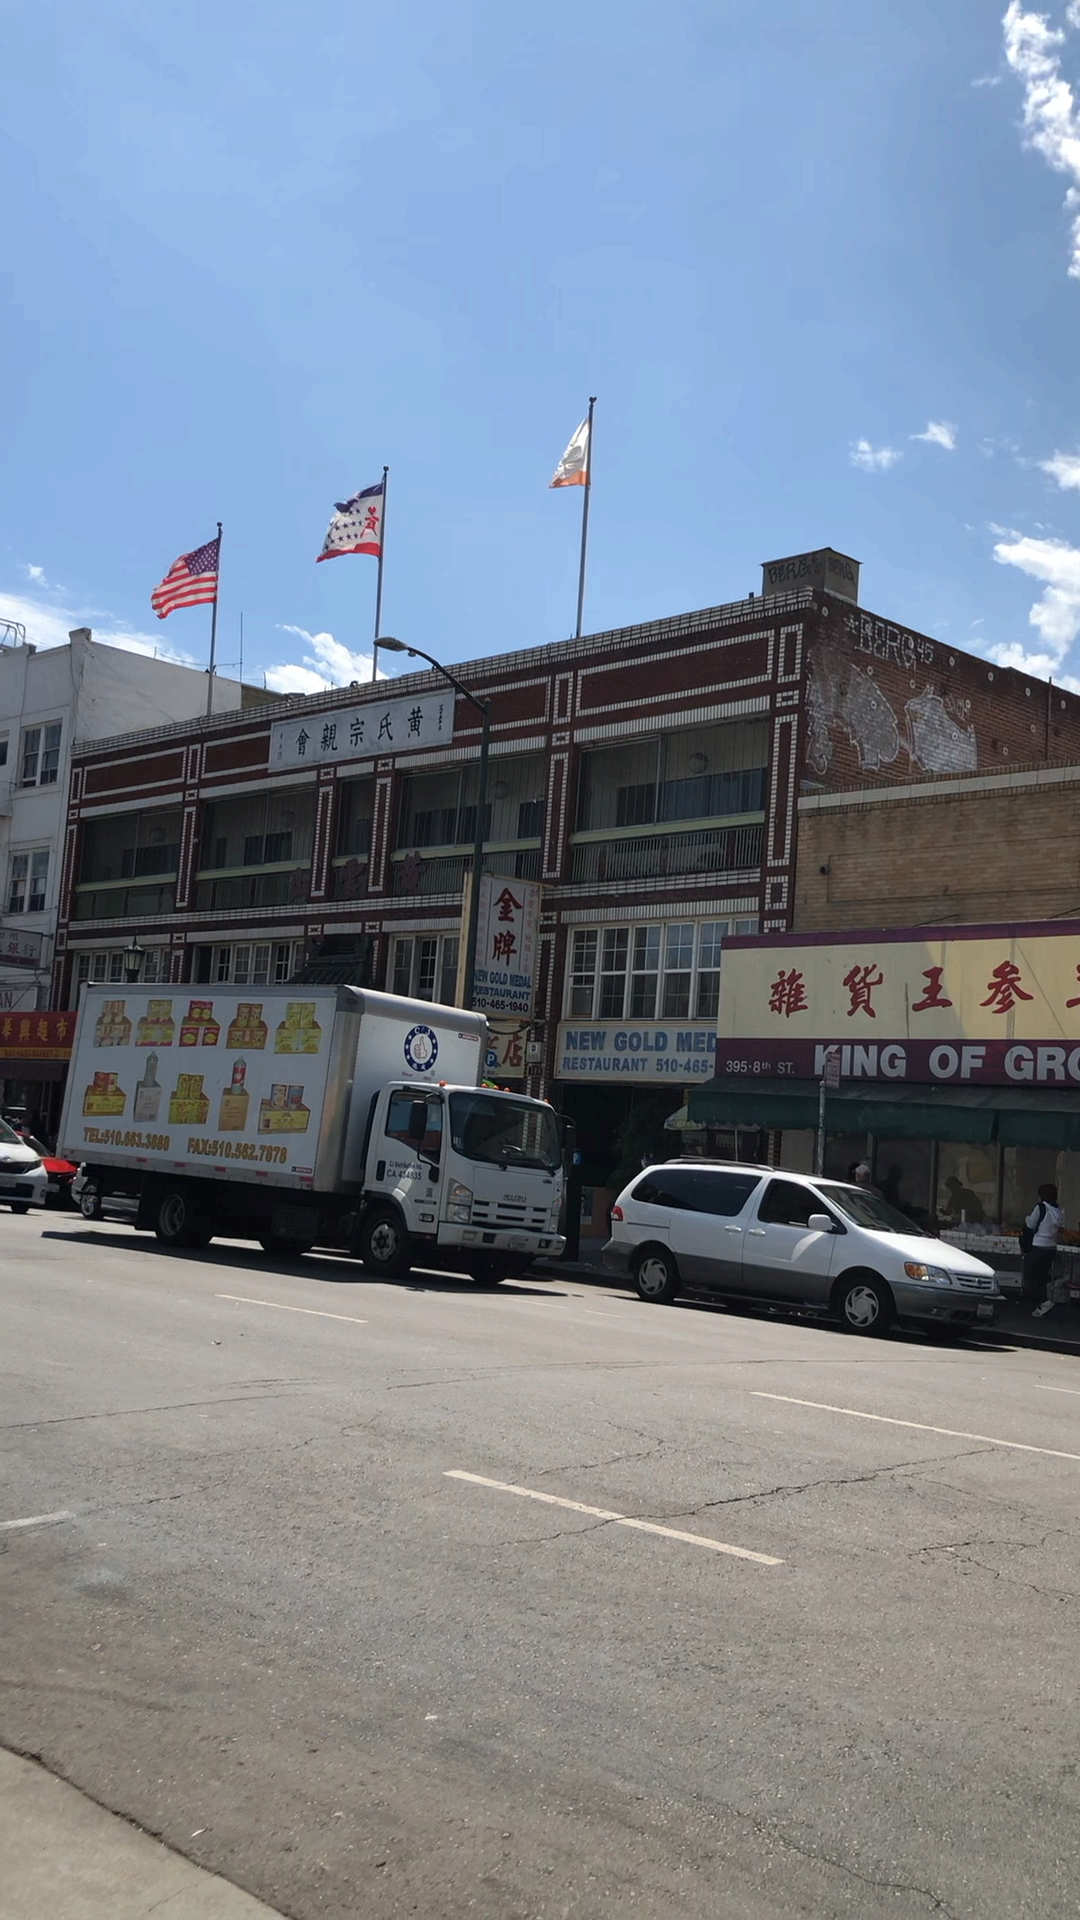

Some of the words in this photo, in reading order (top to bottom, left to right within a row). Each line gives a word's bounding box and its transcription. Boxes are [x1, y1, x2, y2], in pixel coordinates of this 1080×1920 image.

[491, 887, 524, 967] 金牌
[474, 969, 489, 983] NEW
[489, 971, 509, 985] GOLD
[509, 974, 532, 989] MEDAL
[473, 985, 532, 1001] RESTAURANT
[565, 1031, 607, 1051] NEW
[613, 1031, 668, 1052] GOLD
[562, 1057, 648, 1072] RESTAURANT
[777, 1061, 795, 1074] ST.
[813, 1044, 907, 1078] KING
[928, 1045, 986, 1080] OF
[387, 1169, 397, 1178] CA
[503, 1194, 528, 1203] ISUZU
